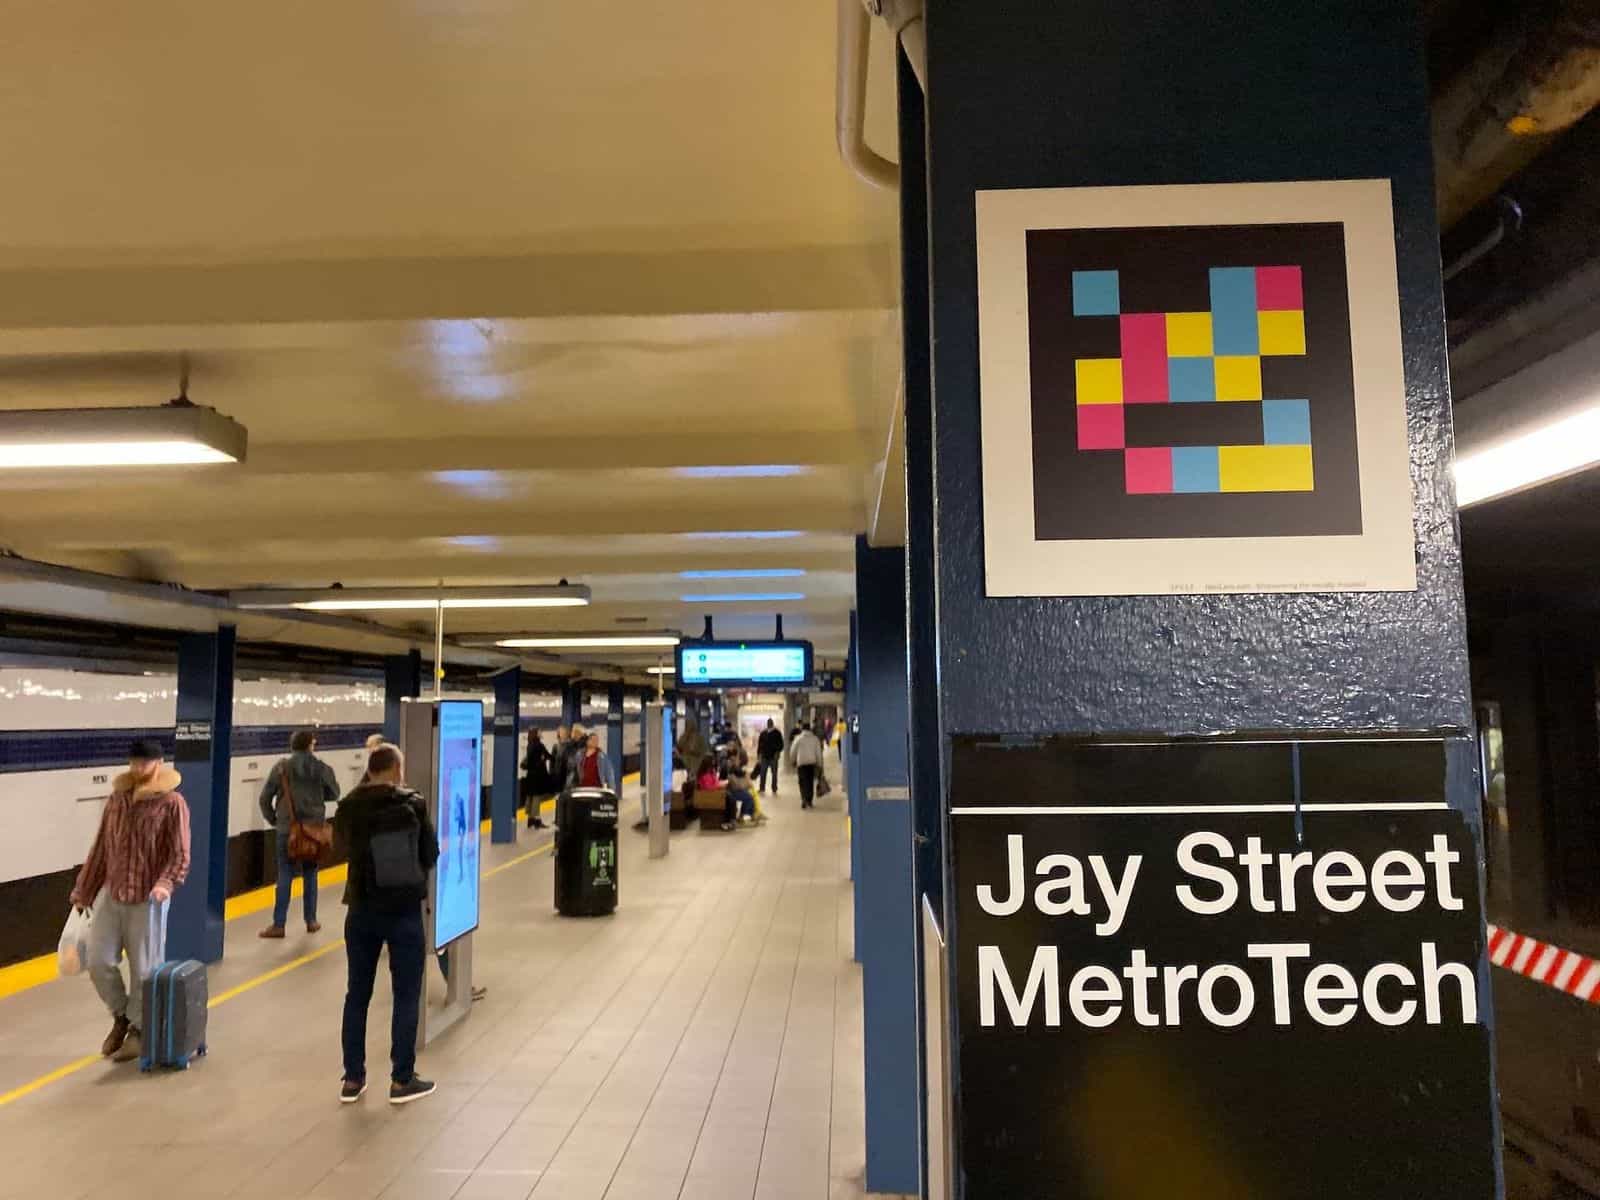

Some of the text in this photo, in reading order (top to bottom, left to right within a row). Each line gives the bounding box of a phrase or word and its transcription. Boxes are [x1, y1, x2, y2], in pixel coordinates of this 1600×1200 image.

[977, 831, 1464, 937] Jay Street
[979, 942, 1477, 1028] MetroTech
